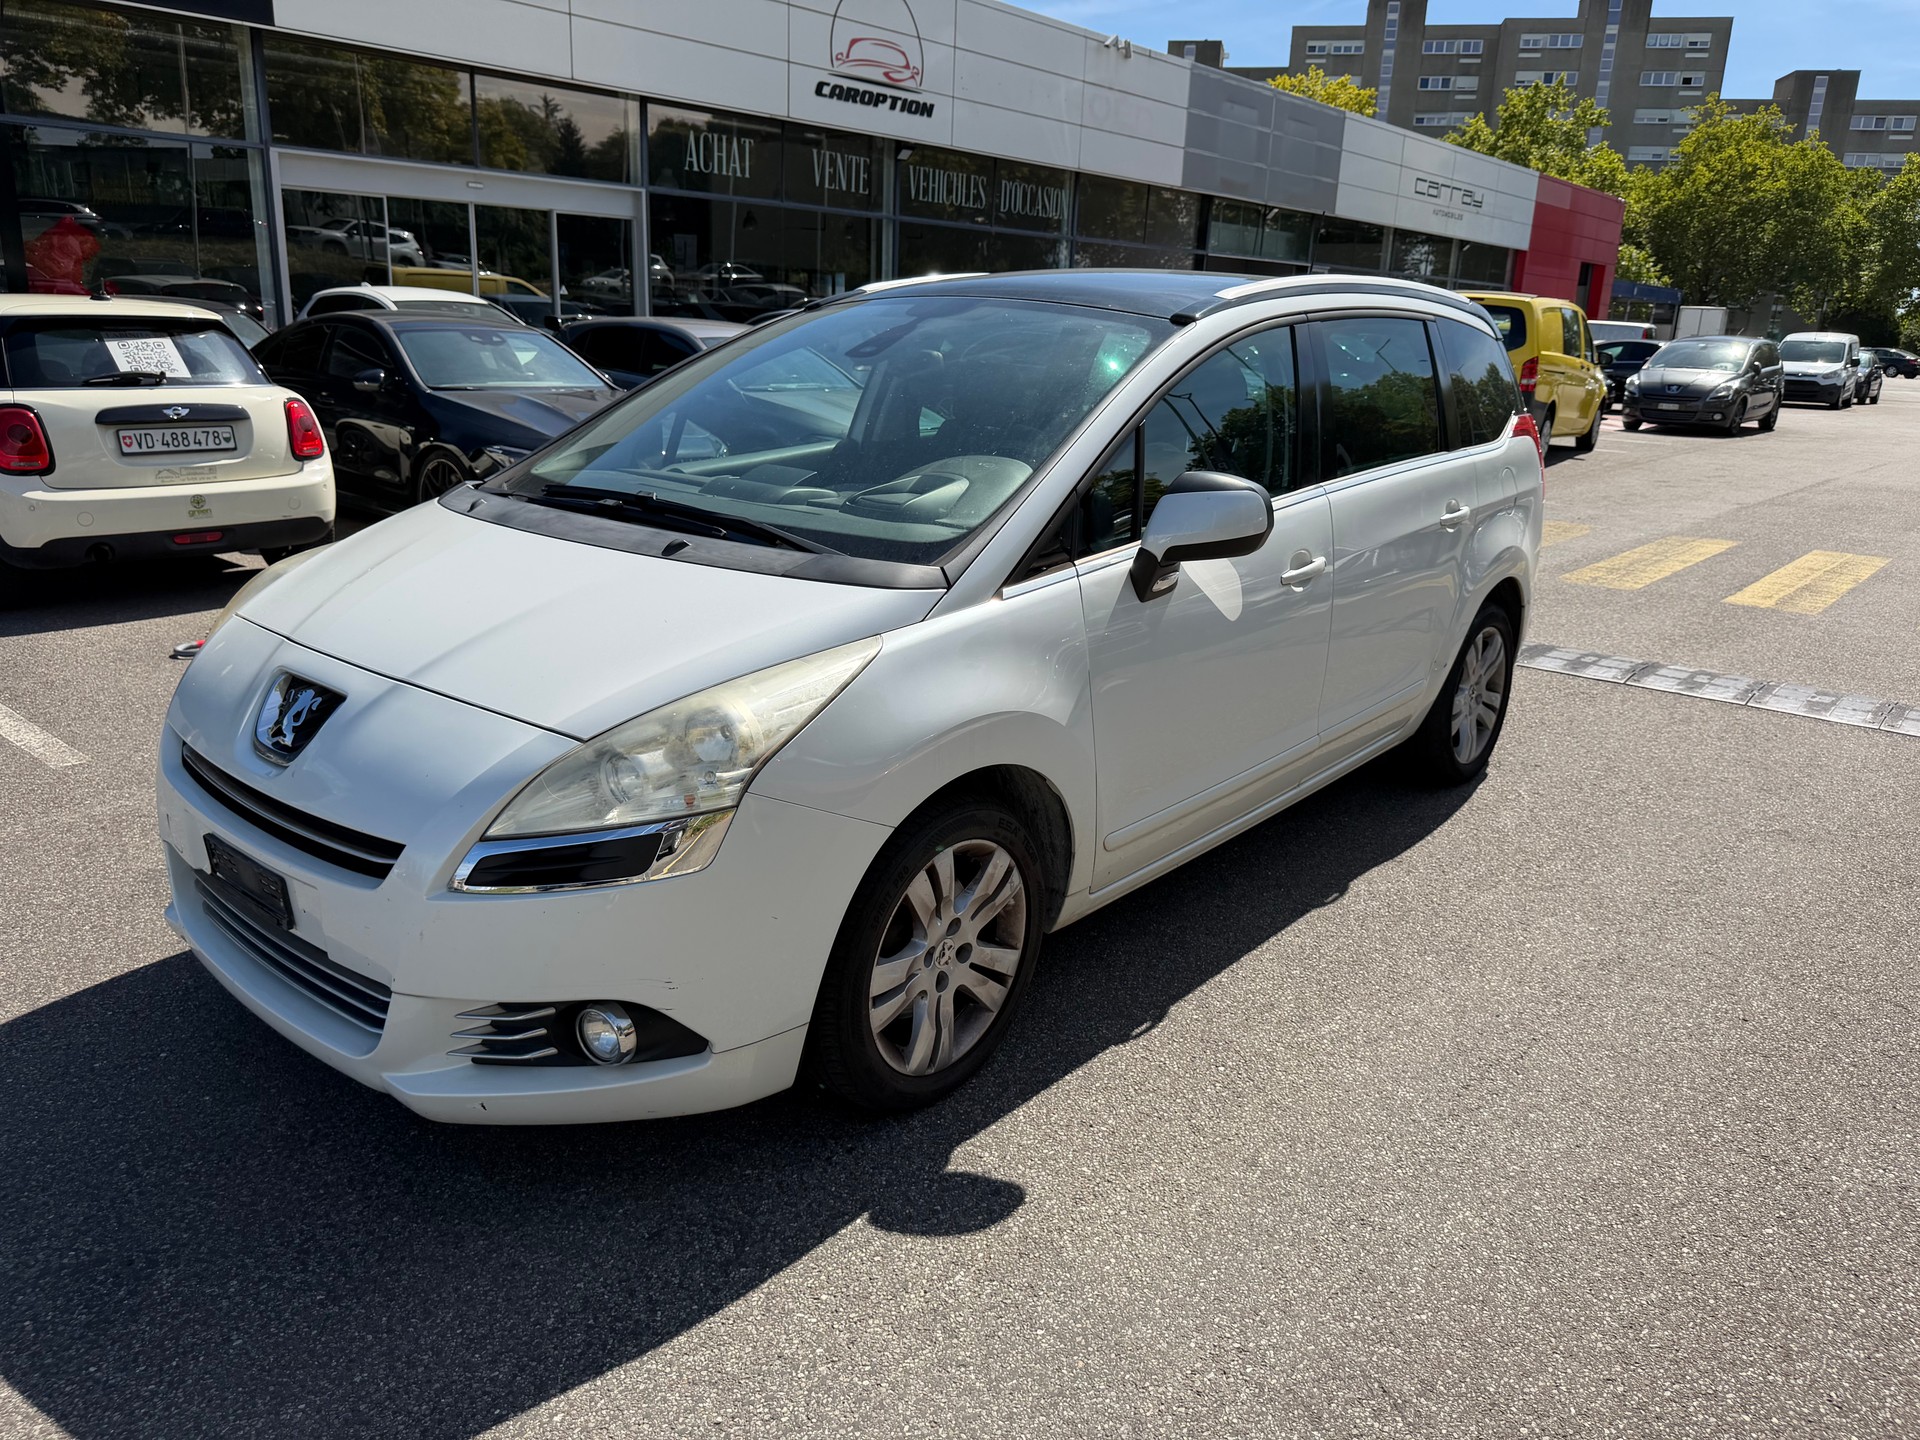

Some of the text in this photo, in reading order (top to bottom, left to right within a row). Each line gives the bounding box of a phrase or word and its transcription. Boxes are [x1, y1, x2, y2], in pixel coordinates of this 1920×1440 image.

[814, 81, 935, 119] CAROPTION
[684, 130, 754, 179] ACHAT
[812, 148, 870, 195] VENTE
[909, 165, 988, 210] VEHICULES
[1414, 177, 1484, 208] carray
